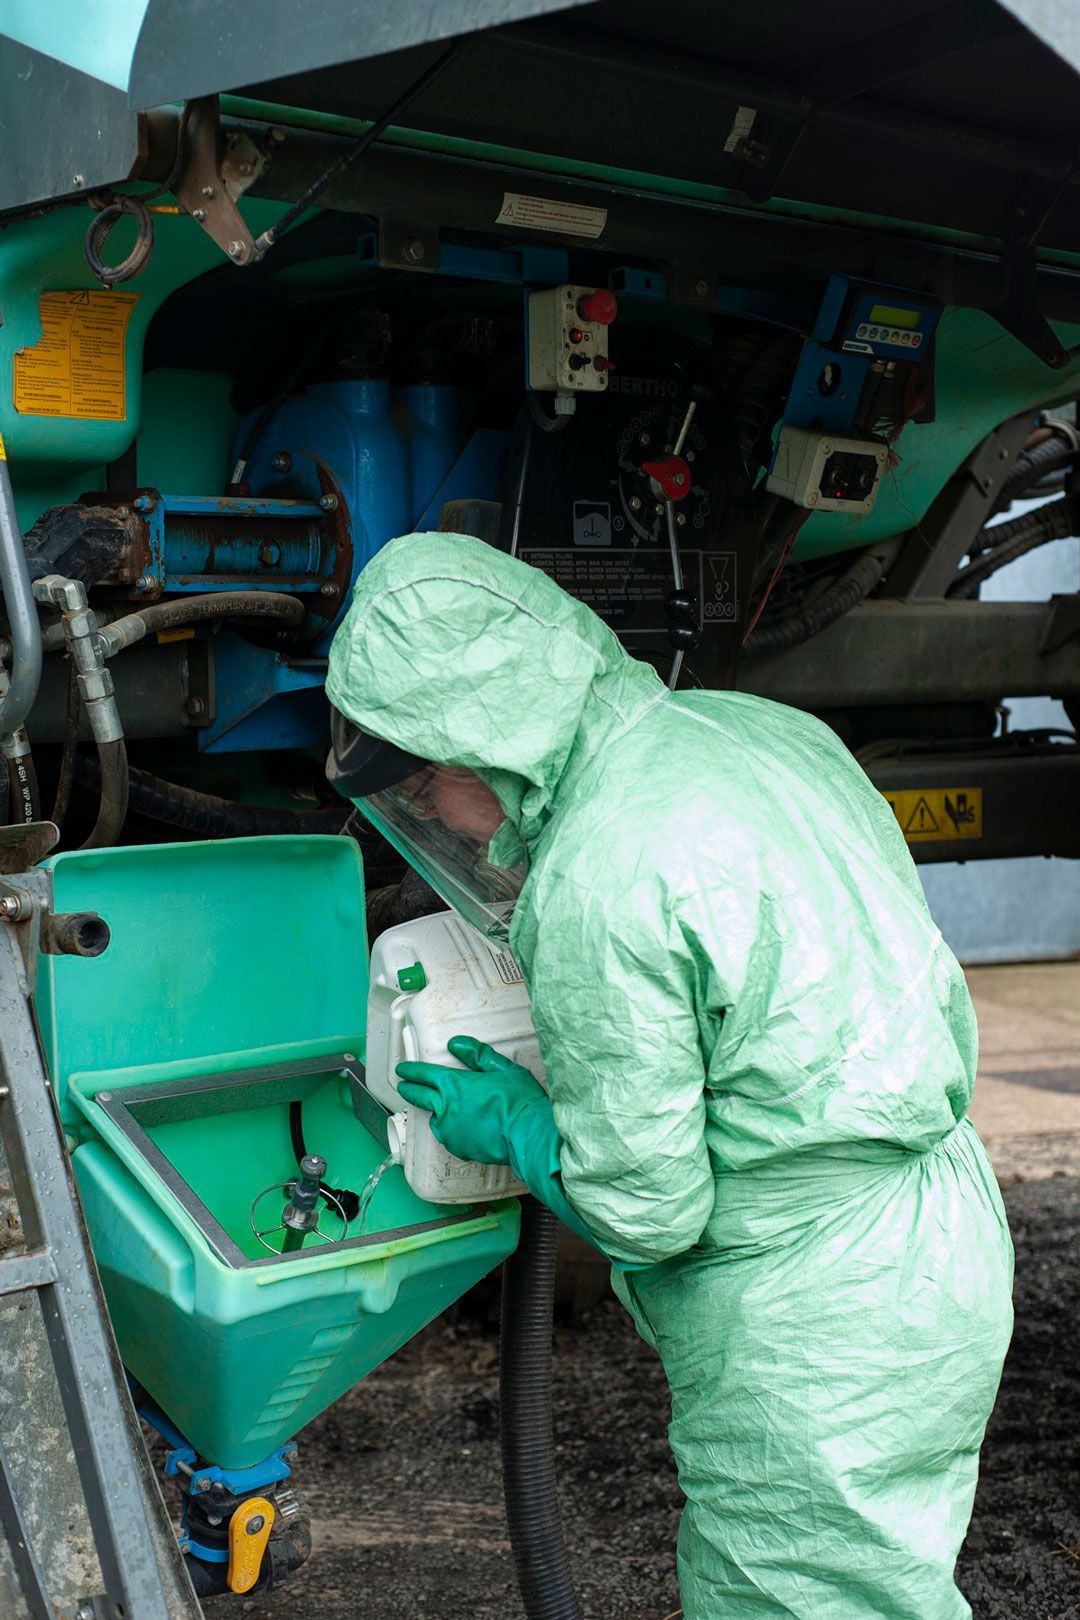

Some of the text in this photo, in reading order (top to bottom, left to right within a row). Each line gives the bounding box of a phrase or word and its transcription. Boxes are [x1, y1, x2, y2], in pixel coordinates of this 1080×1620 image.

[609, 376, 682, 398] BERTHO
[17, 765, 27, 782] 4SH
[22, 786, 31, 801] WP
[24, 802, 33, 816] 420
